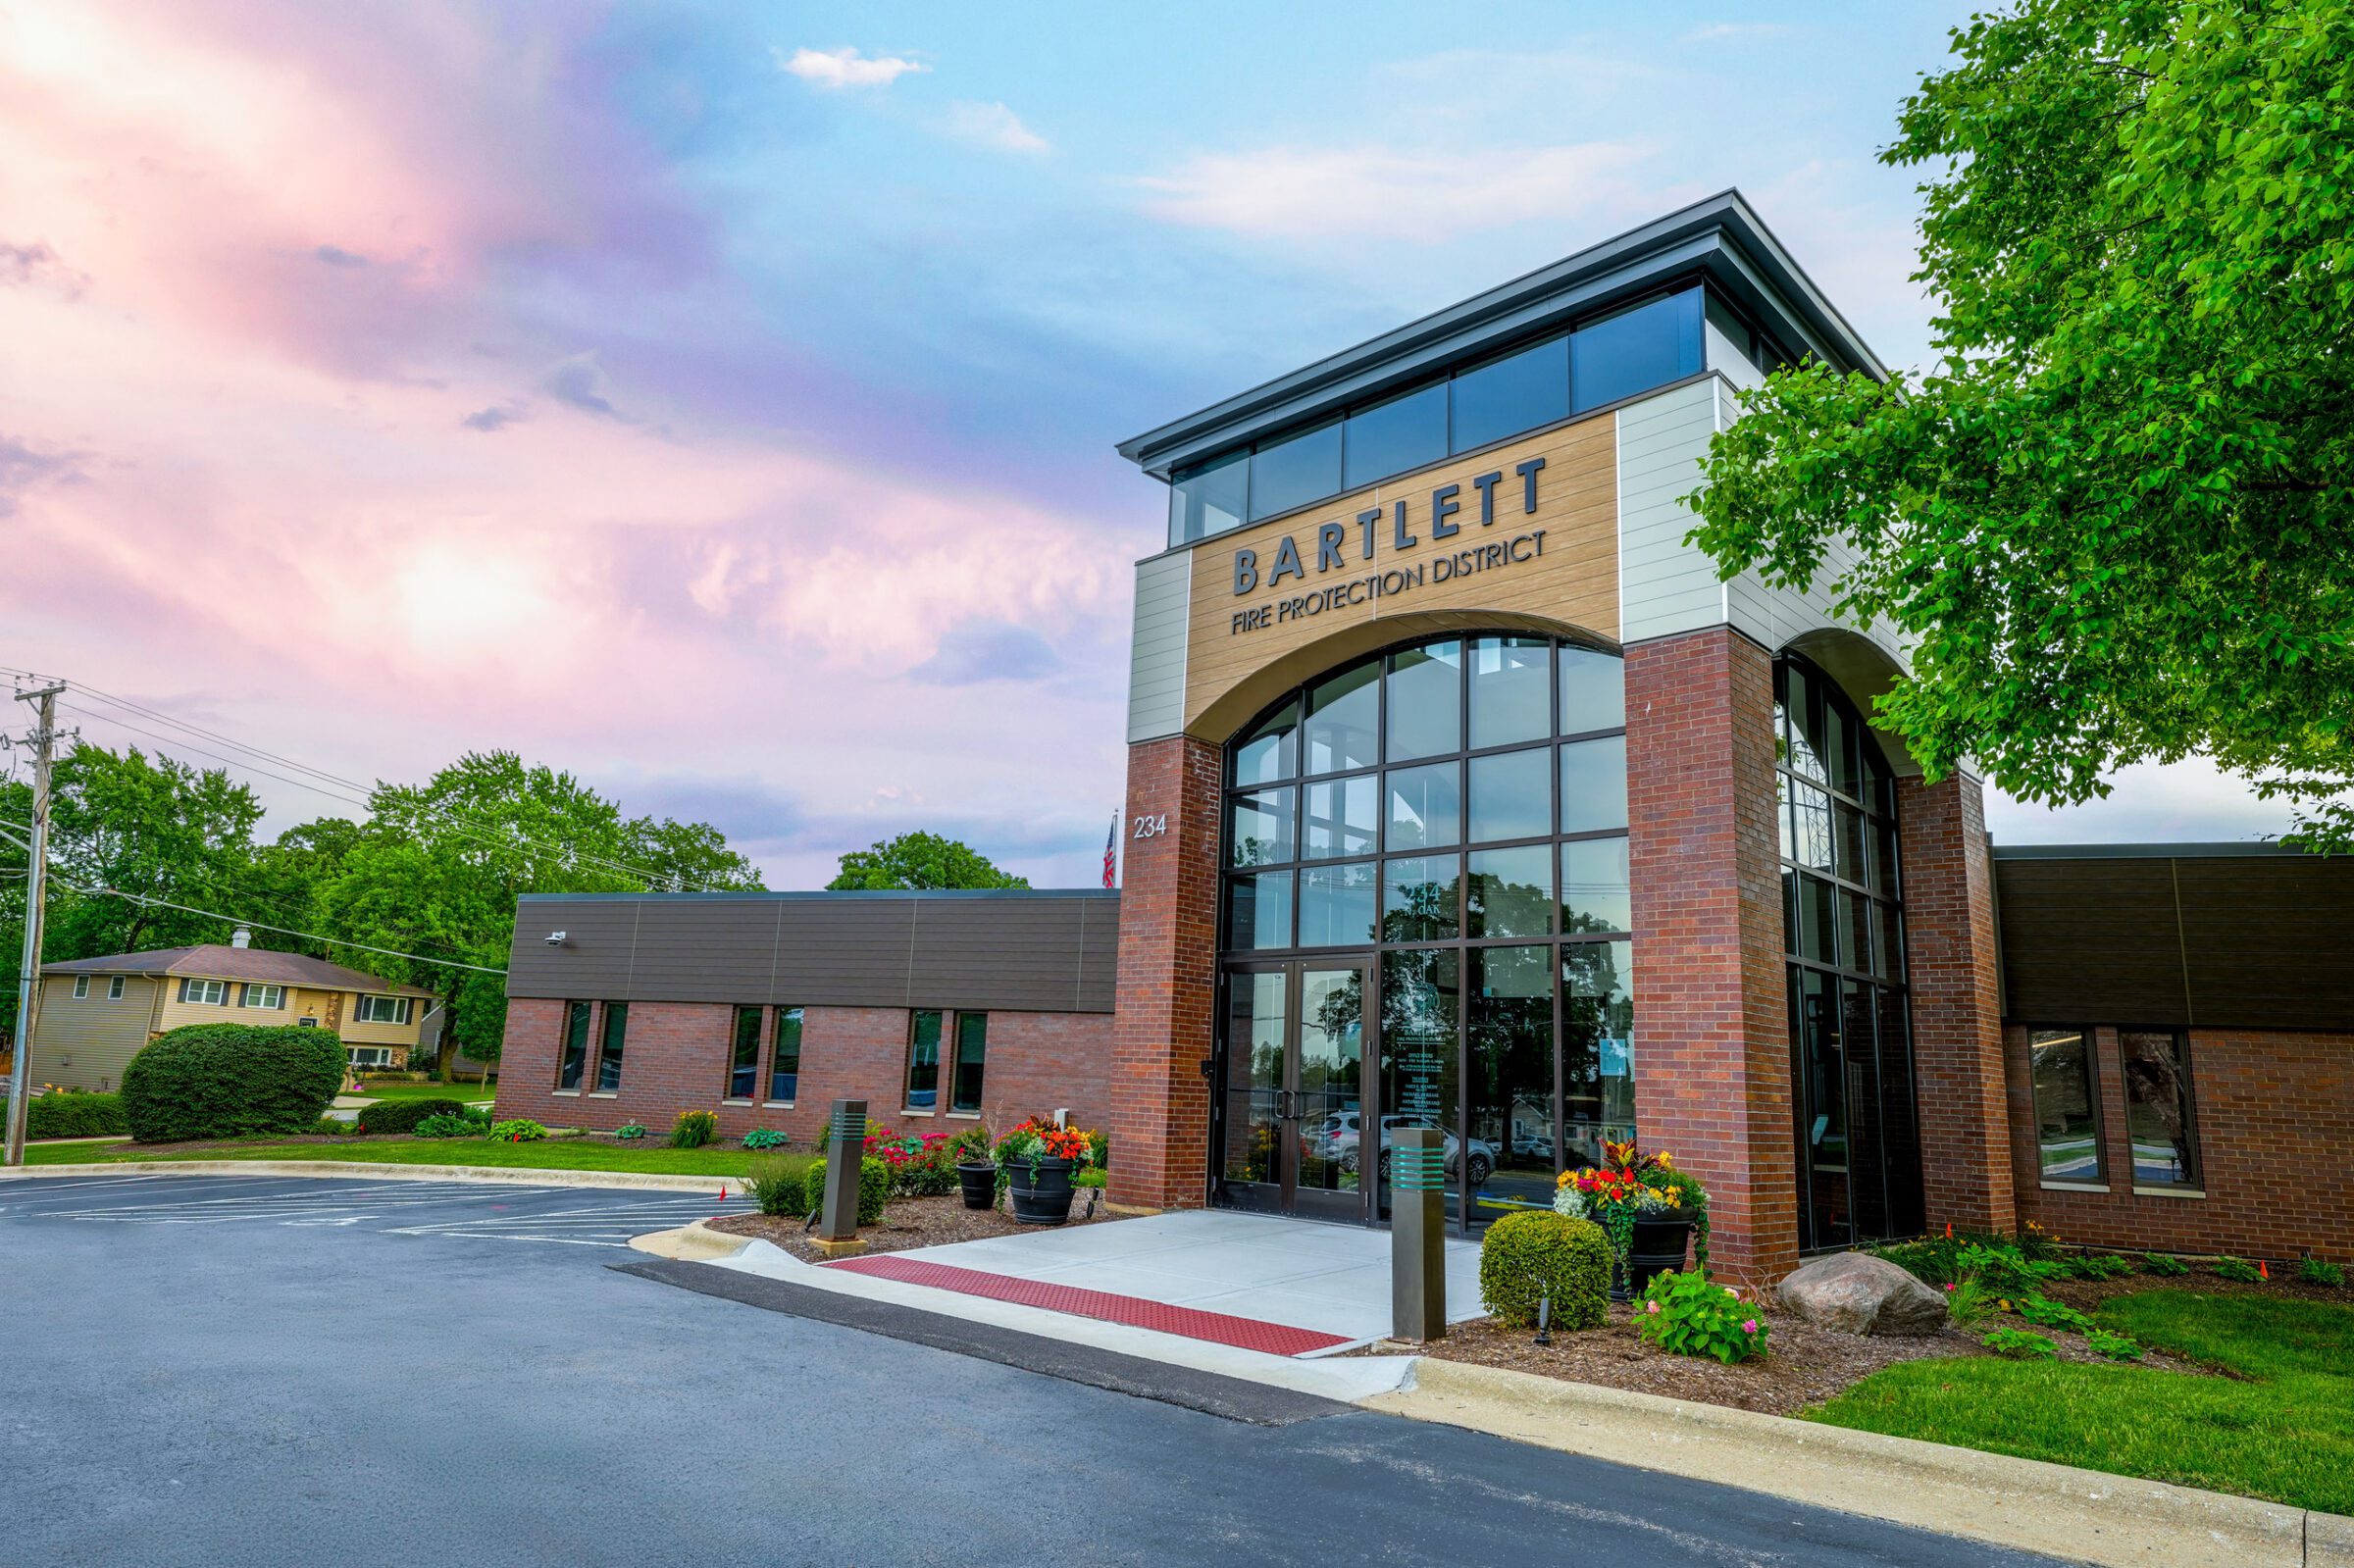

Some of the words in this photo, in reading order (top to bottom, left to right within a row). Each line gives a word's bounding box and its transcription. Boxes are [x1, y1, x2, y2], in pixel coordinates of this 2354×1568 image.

[1233, 457, 1546, 596] BARTLETT
[1231, 603, 1272, 635] FIRE
[1277, 563, 1423, 623] PROTECTION
[1432, 530, 1546, 583] DISTRICT
[1133, 813, 1167, 839] 234
[1404, 885, 1441, 904] 234
[1417, 904, 1441, 915] OAK
